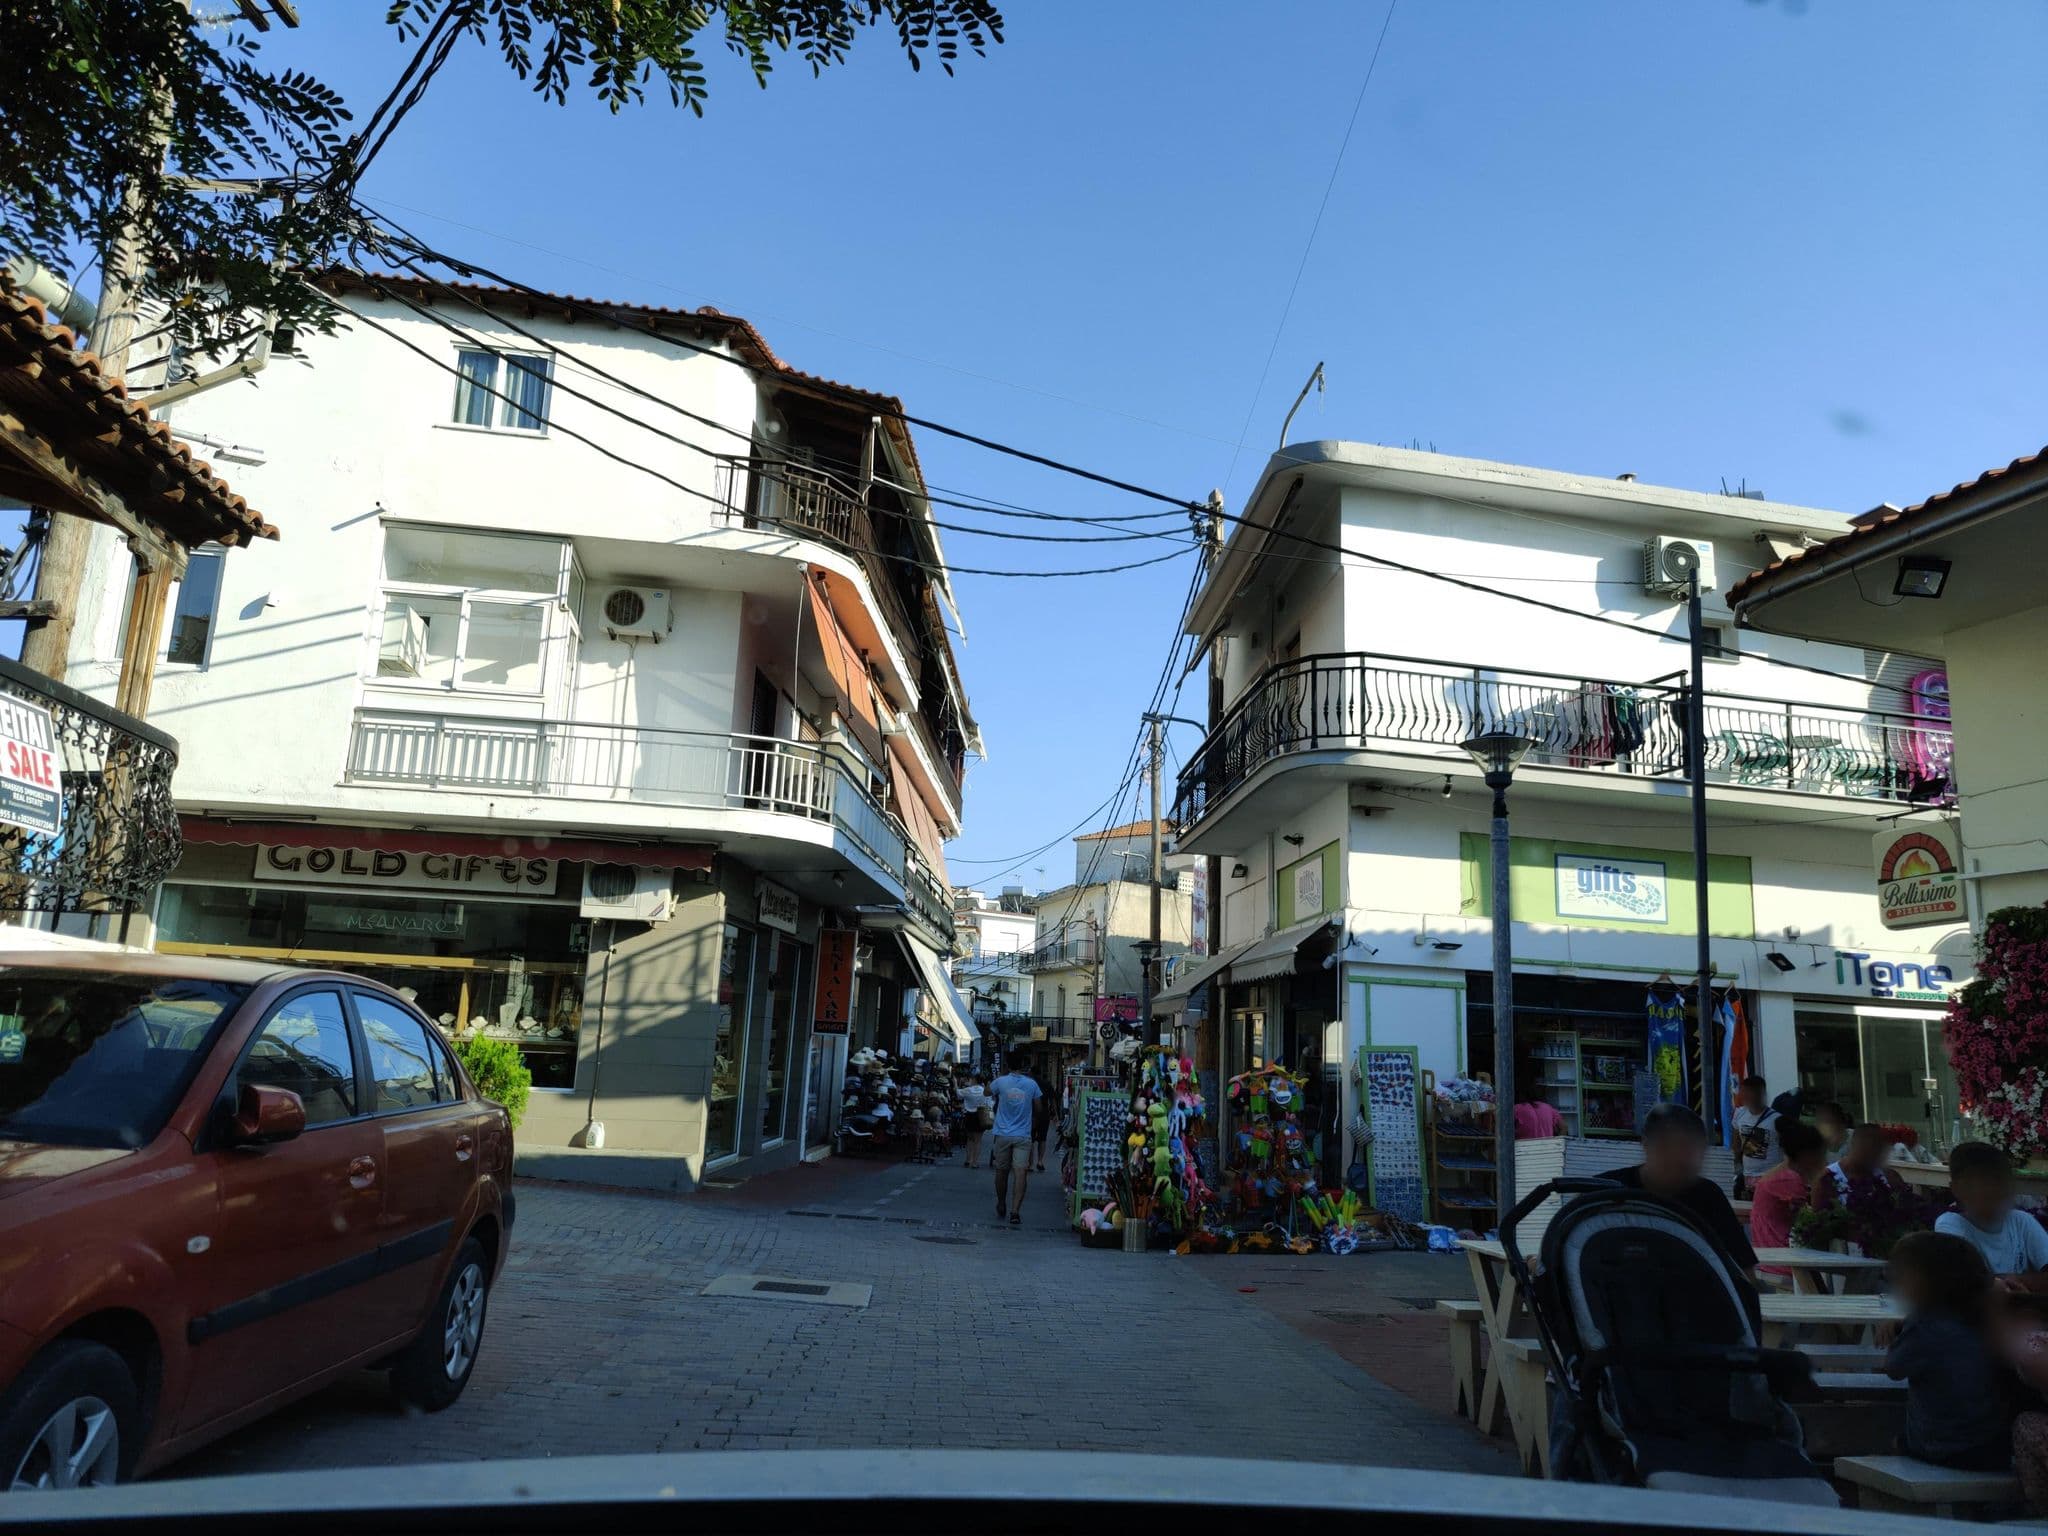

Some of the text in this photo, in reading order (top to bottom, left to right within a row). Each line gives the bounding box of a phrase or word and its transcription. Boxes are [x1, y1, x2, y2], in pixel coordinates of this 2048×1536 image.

[8, 741, 54, 787] SALE
[266, 845, 407, 876] GOLD
[1578, 864, 1637, 894] gifts
[1881, 882, 1957, 909] Bellissimo
[1835, 951, 1953, 991] iTone
